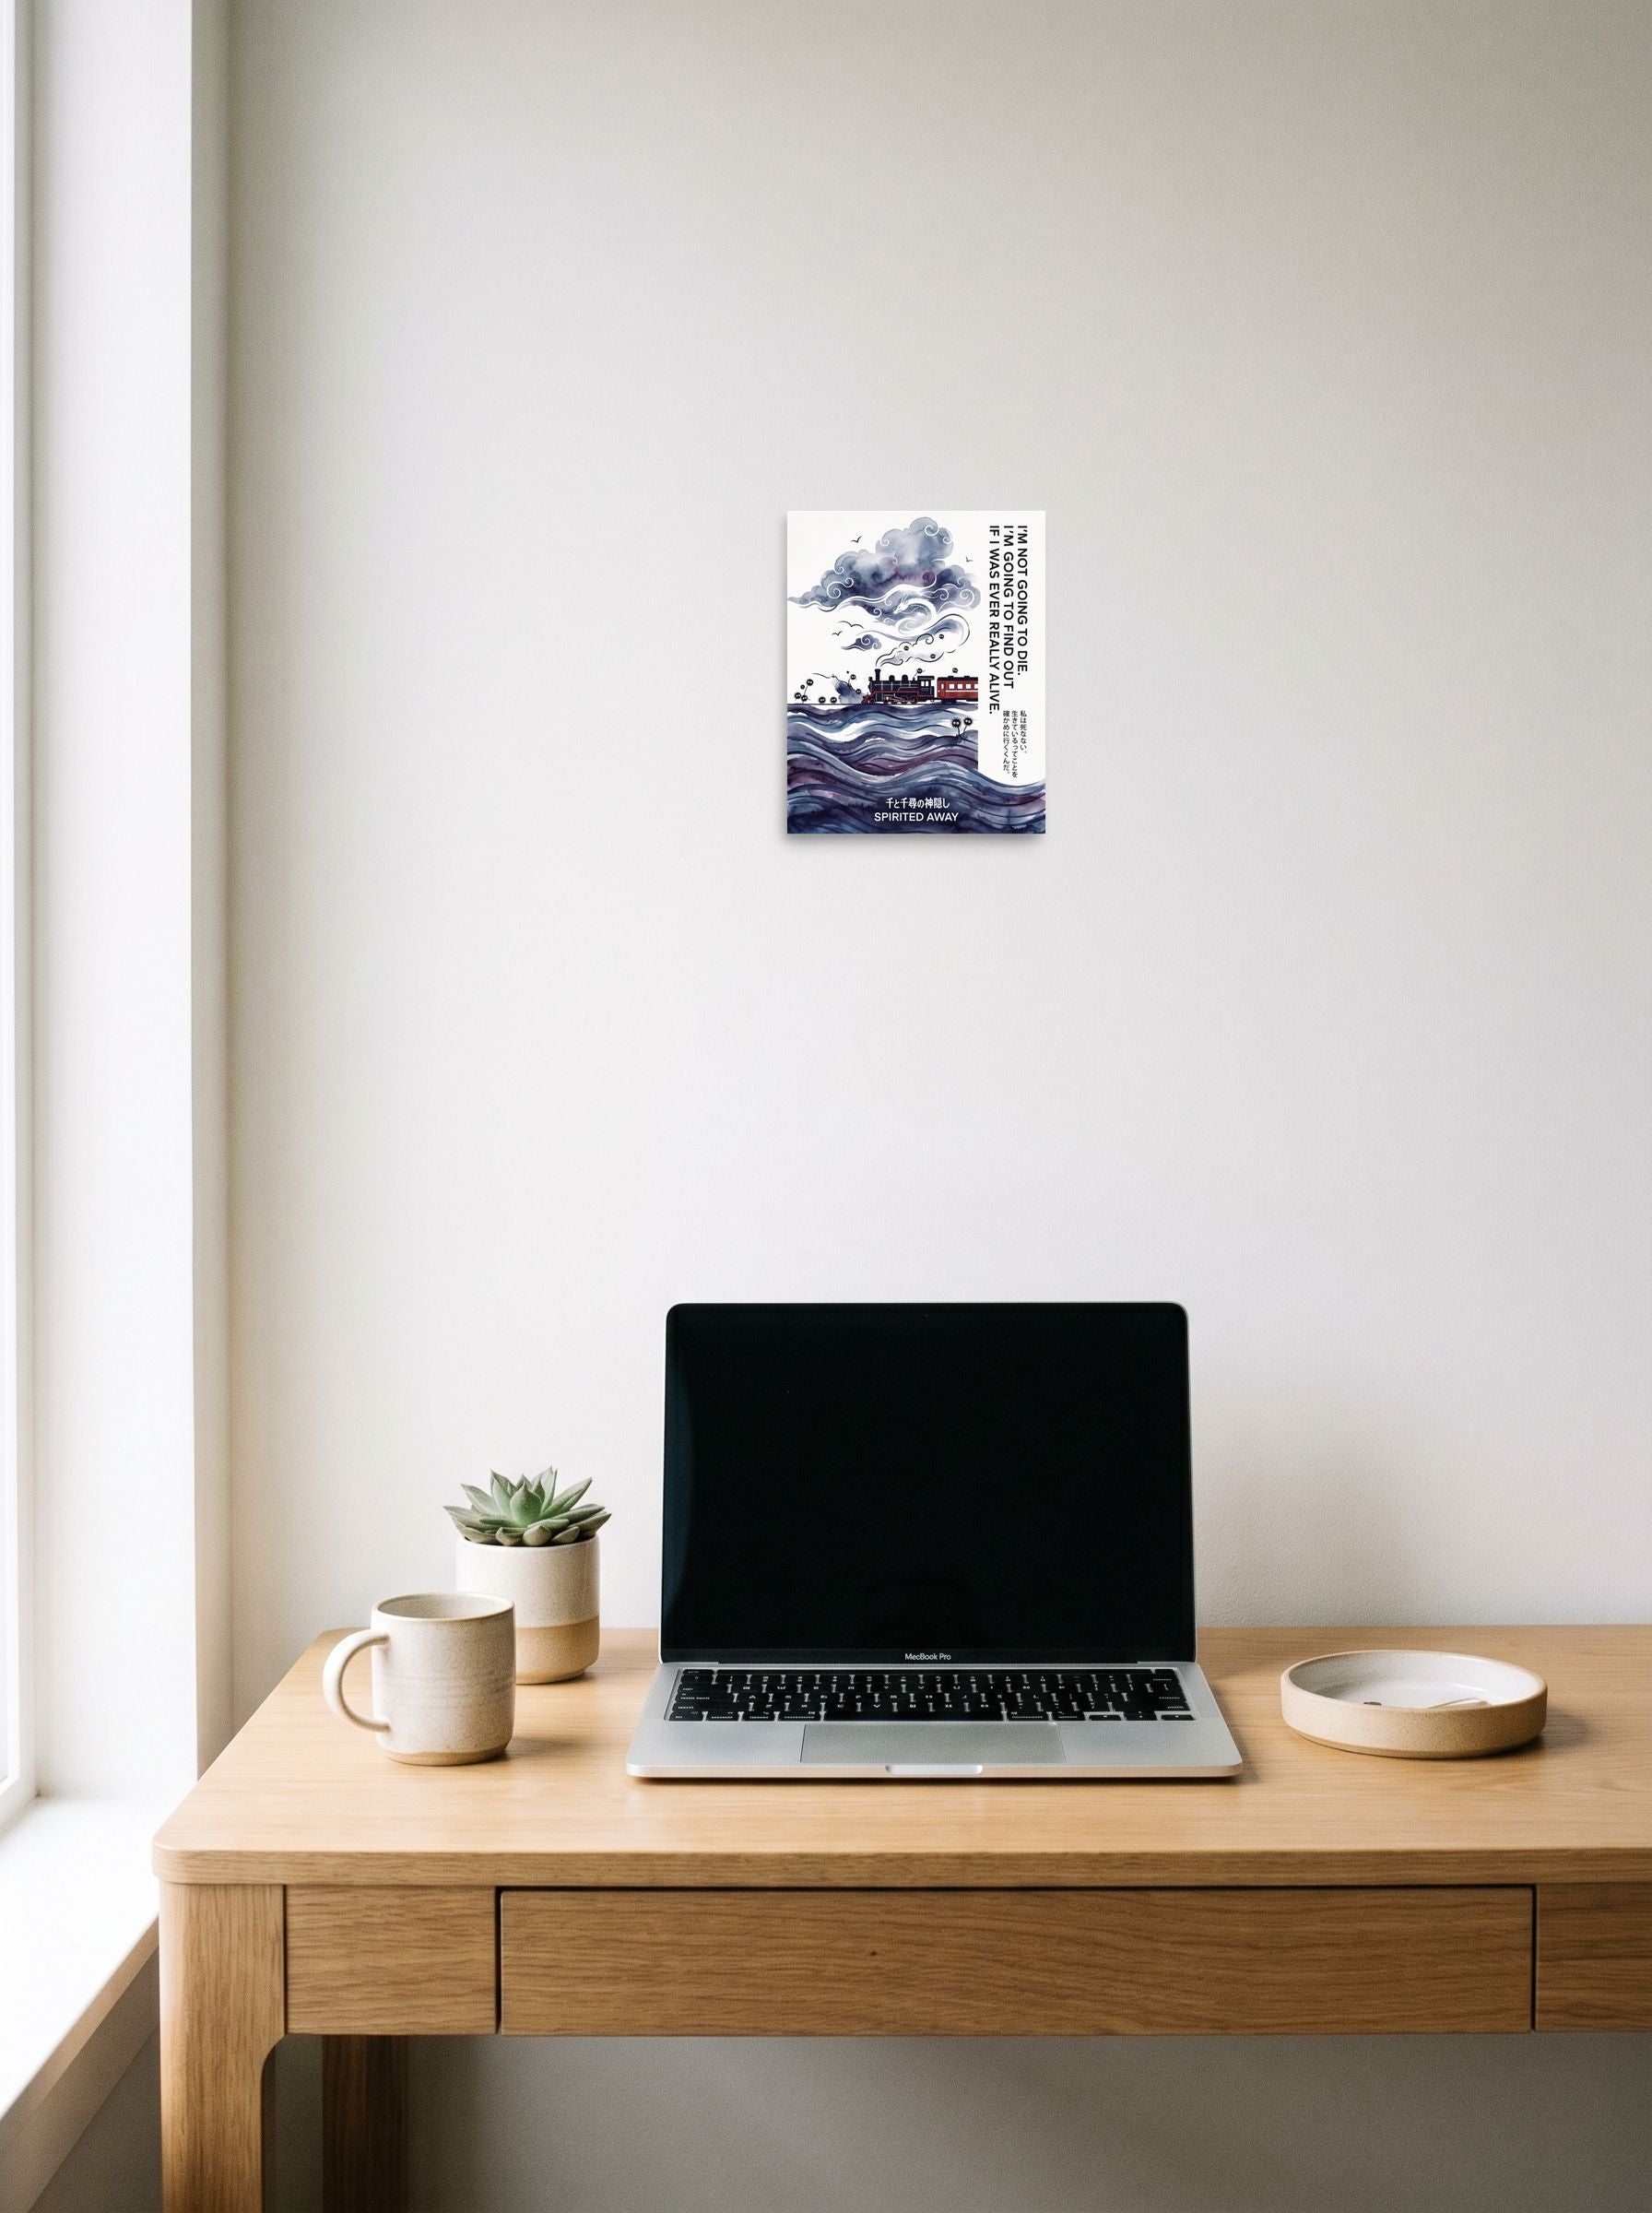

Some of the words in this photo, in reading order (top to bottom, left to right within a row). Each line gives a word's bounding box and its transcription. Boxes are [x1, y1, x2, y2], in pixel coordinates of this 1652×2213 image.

[989, 525, 1000, 537] IF
[1003, 525, 1014, 547] I'M
[1017, 525, 1028, 544] I'M
[989, 548, 1000, 579] WAS
[1003, 551, 1014, 598] GOING
[1017, 548, 1028, 576] NOT
[989, 583, 1000, 618] EVER
[1003, 601, 1014, 621] TO
[1017, 579, 1028, 625] GOING
[989, 621, 1000, 671] REALLY
[1003, 624, 1014, 657] FIND
[1017, 628, 1028, 647] TO
[1003, 660, 1014, 690] OUT
[1017, 650, 1028, 676] DIE.
[989, 672, 1000, 715] ALIVE.
[874, 812, 925, 822] SPIRITED
[926, 812, 960, 822] AWAY
[885, 797, 950, 810] 千と千尋の神隠し
[938, 1652, 952, 1661] Pro
